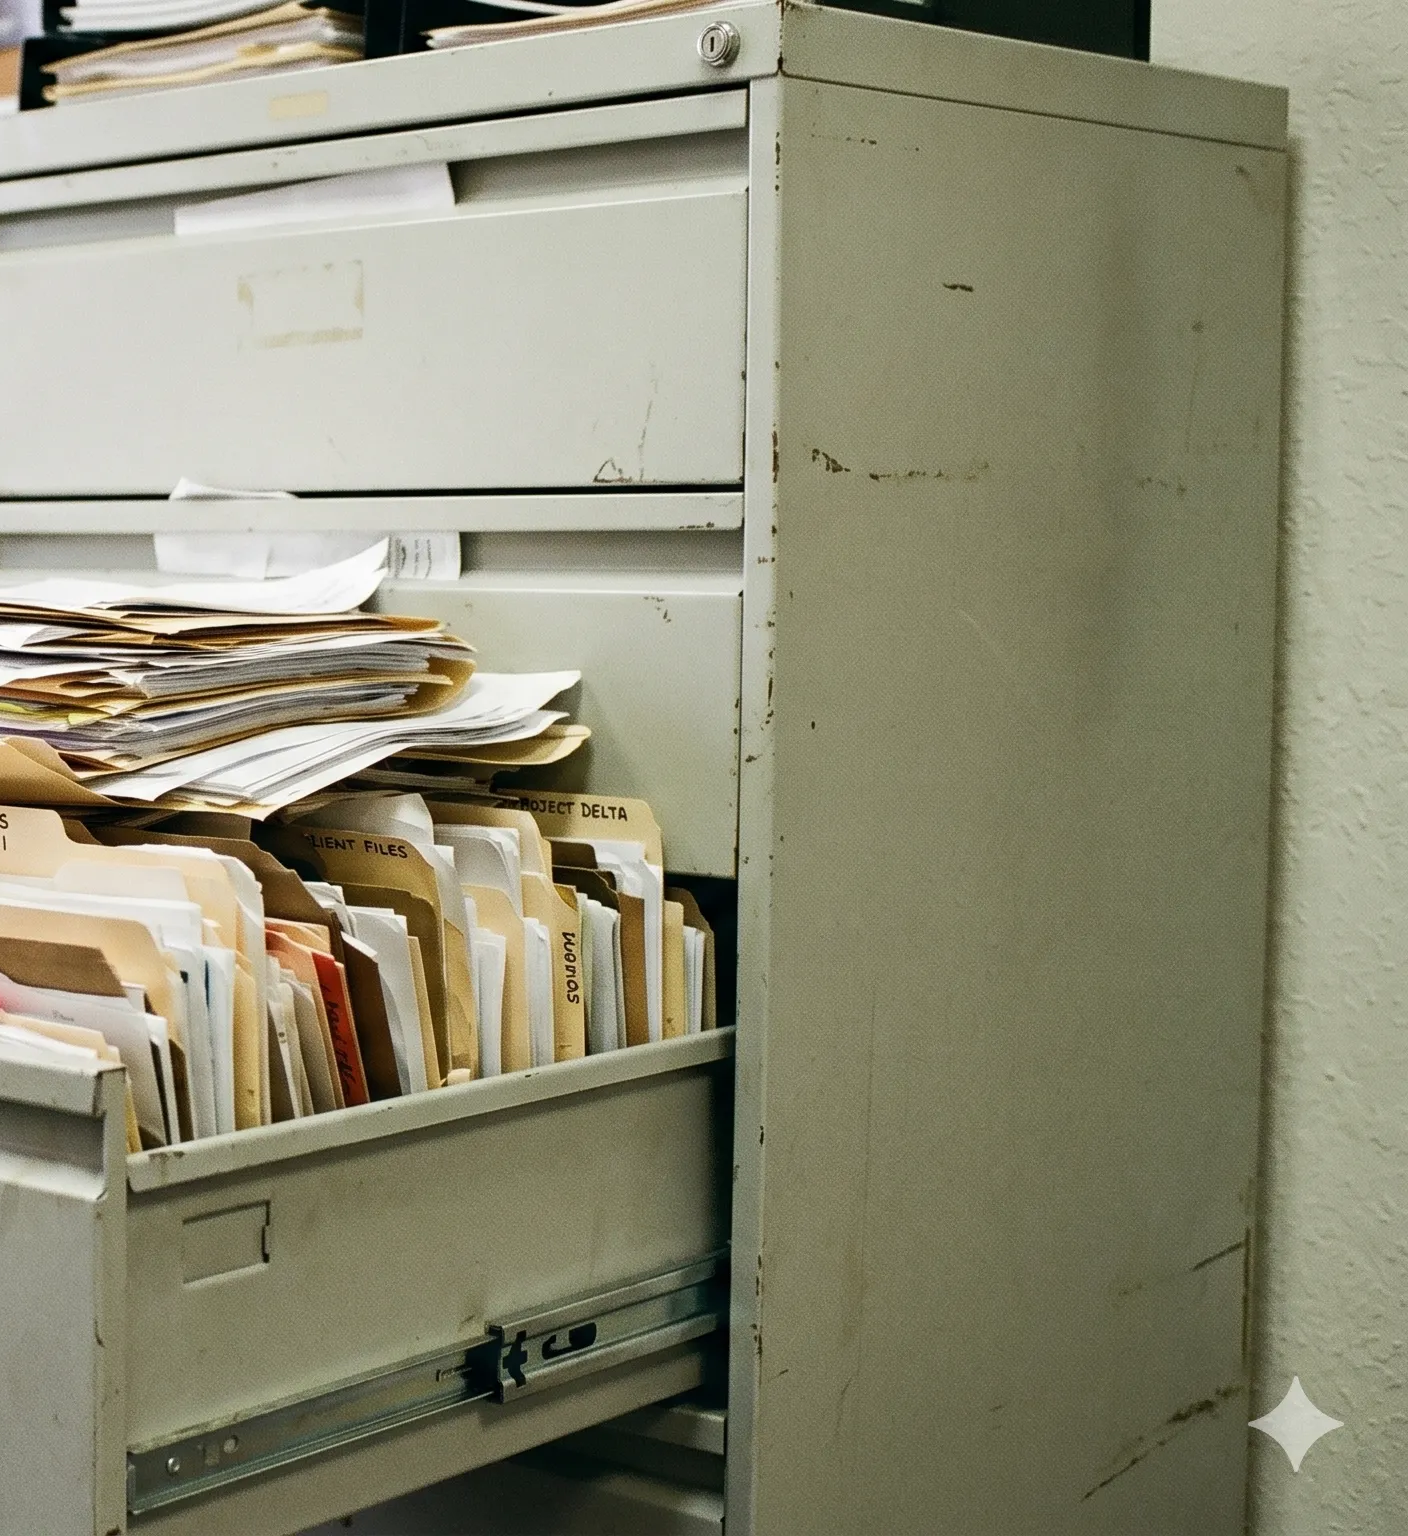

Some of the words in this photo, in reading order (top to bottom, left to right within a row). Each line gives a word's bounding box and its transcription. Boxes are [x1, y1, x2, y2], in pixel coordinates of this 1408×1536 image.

[580, 802, 628, 821] DELTA
[306, 835, 355, 850] LIENT
[363, 840, 408, 859] FILES
